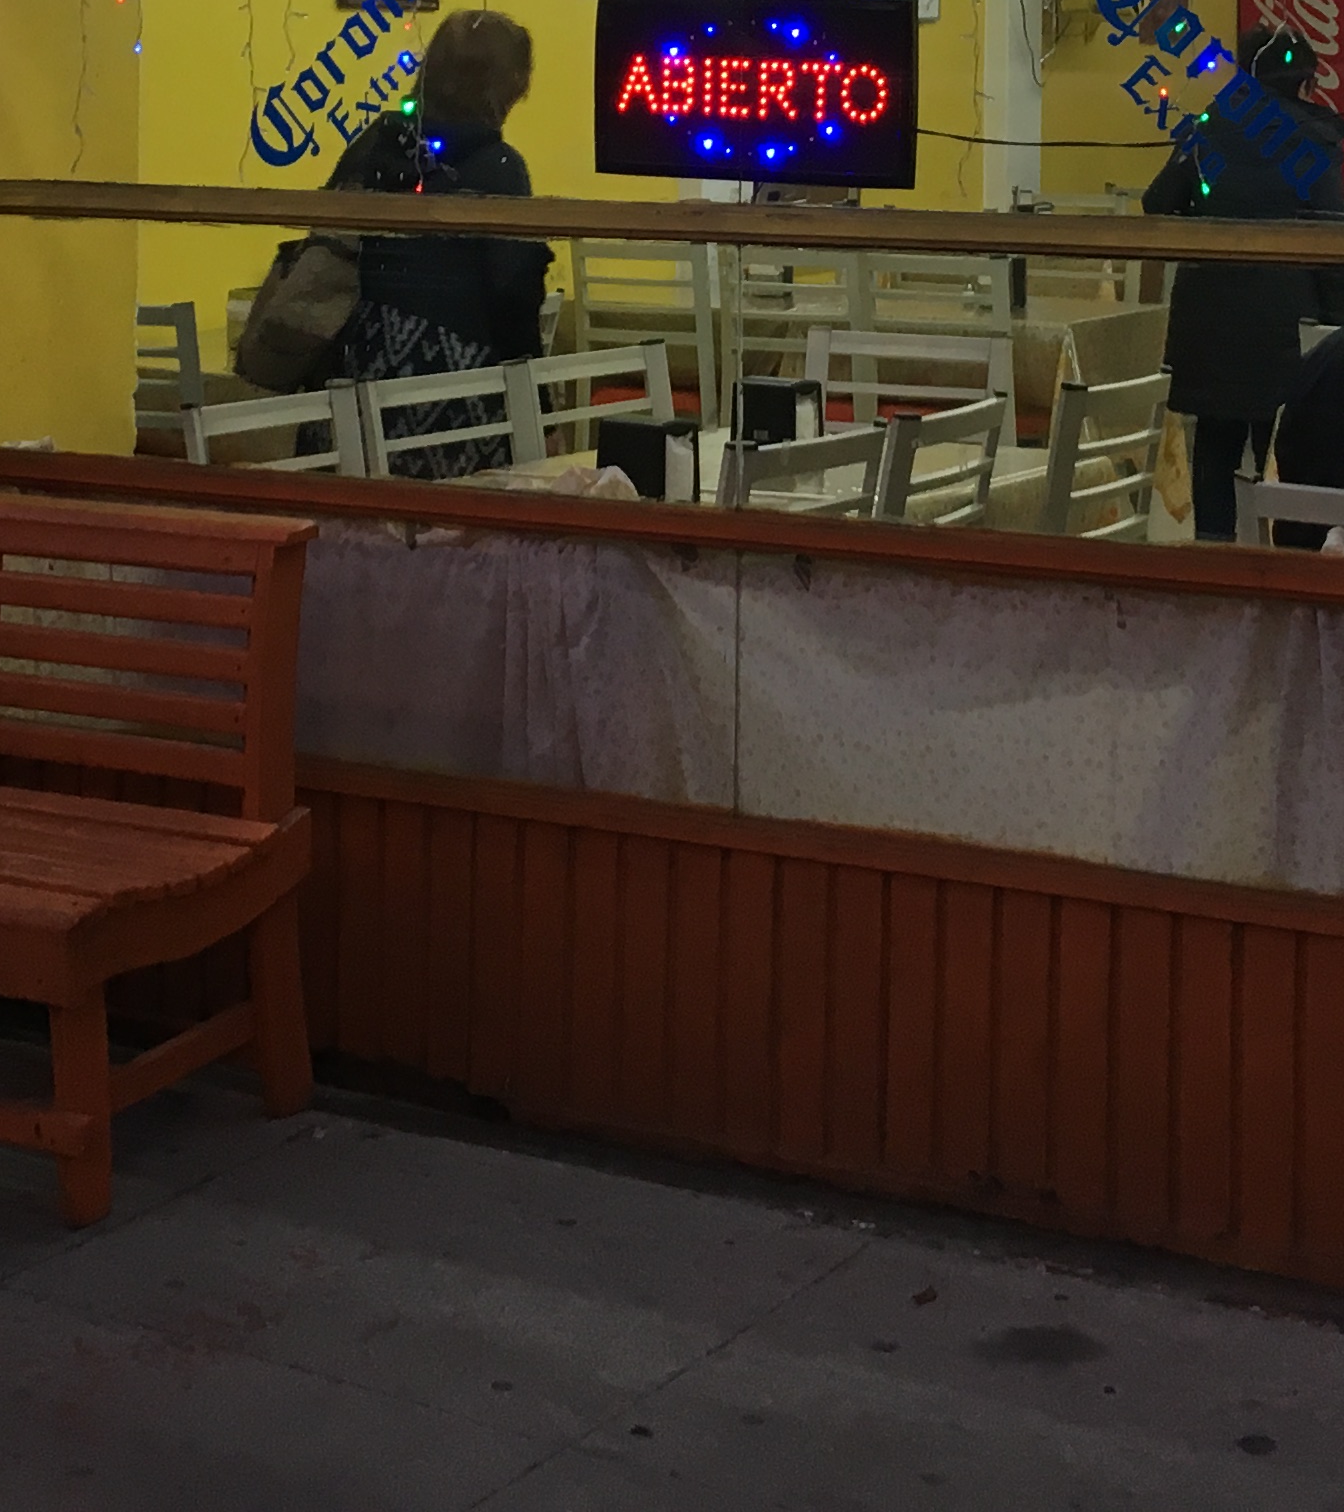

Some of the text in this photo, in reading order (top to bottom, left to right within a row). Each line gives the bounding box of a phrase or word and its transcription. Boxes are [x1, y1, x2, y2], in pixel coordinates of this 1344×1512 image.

[326, 49, 423, 147] Extra
[615, 52, 891, 125] ABIERTO
[1119, 54, 1227, 185] Extra
